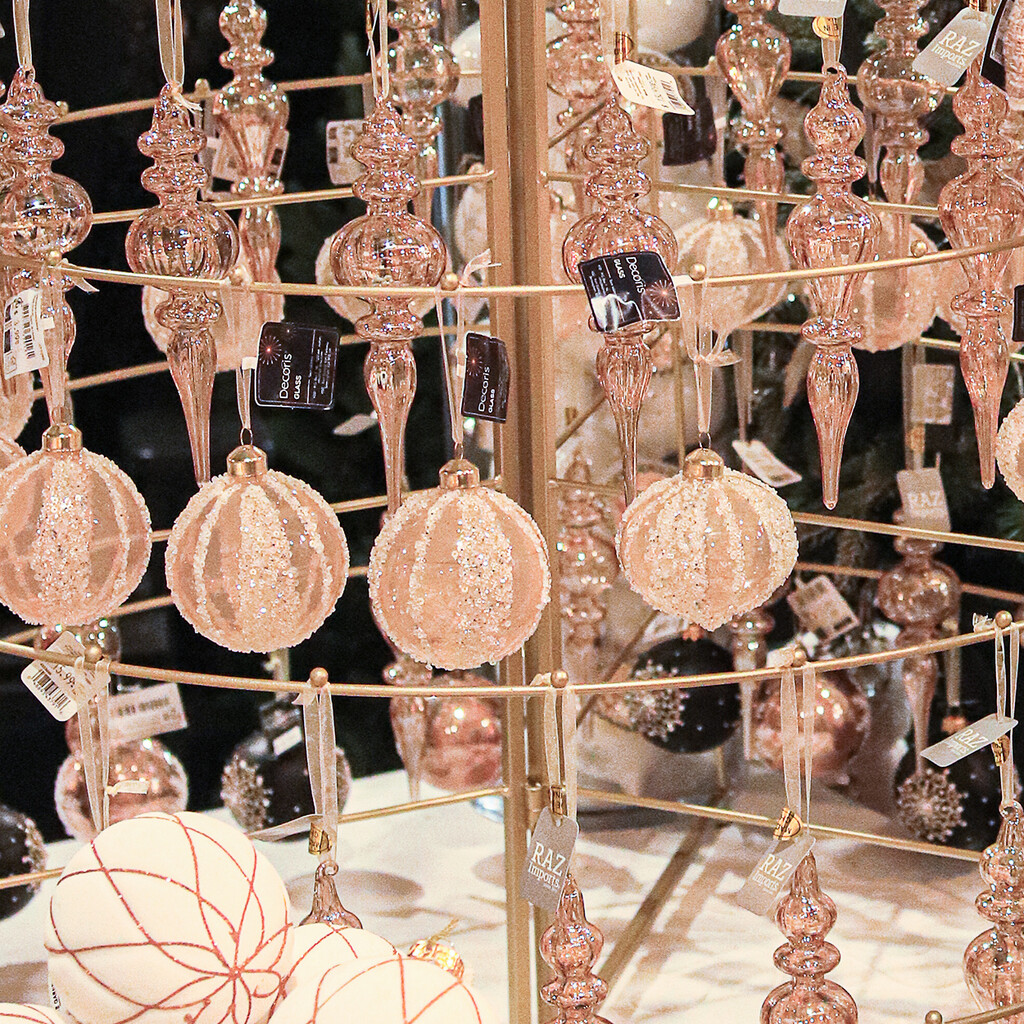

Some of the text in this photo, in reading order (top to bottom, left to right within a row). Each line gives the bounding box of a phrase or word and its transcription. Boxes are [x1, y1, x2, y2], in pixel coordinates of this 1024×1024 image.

[939, 29, 981, 57] RAZ
[626, 256, 646, 294] Decoris
[279, 352, 293, 399] Decoris
[293, 375, 302, 400] GLASS
[477, 366, 491, 412] Decoris
[954, 728, 988, 750] RAZ
[527, 859, 561, 889] Imports
[531, 841, 566, 877] RAZ
[759, 853, 793, 881] RAZ
